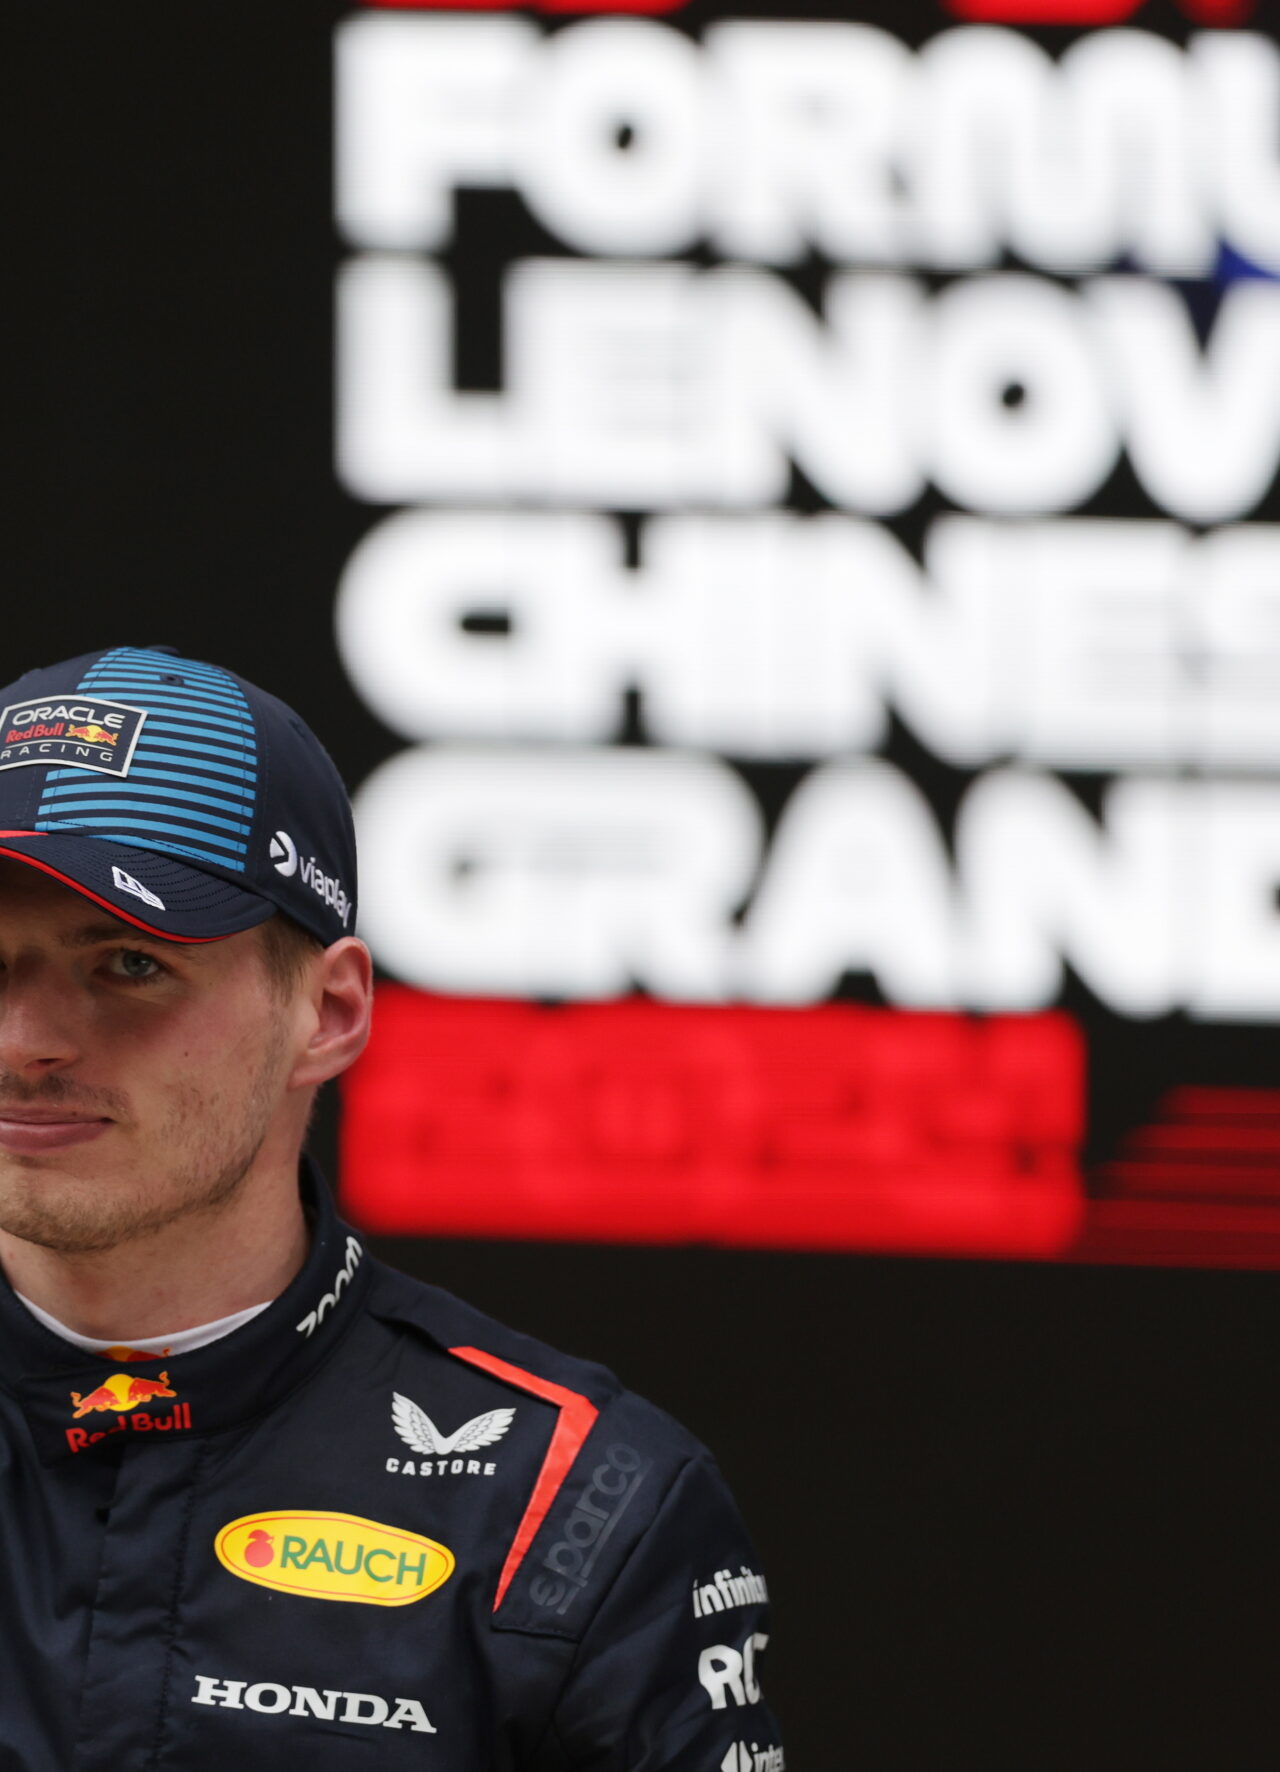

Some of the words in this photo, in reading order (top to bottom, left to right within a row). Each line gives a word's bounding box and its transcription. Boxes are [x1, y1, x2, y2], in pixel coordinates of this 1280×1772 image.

[12, 705, 126, 729] ORACLE
[5, 725, 35, 744] Red
[34, 722, 65, 738] Bull
[0, 743, 114, 763] RACING
[300, 856, 352, 929] viaplay
[131, 1402, 192, 1431] Bull
[386, 1458, 496, 1477] CASTORE
[530, 1443, 652, 1614] sparco
[279, 1535, 427, 1587] RAUCH
[191, 1675, 437, 1734] HONDA
